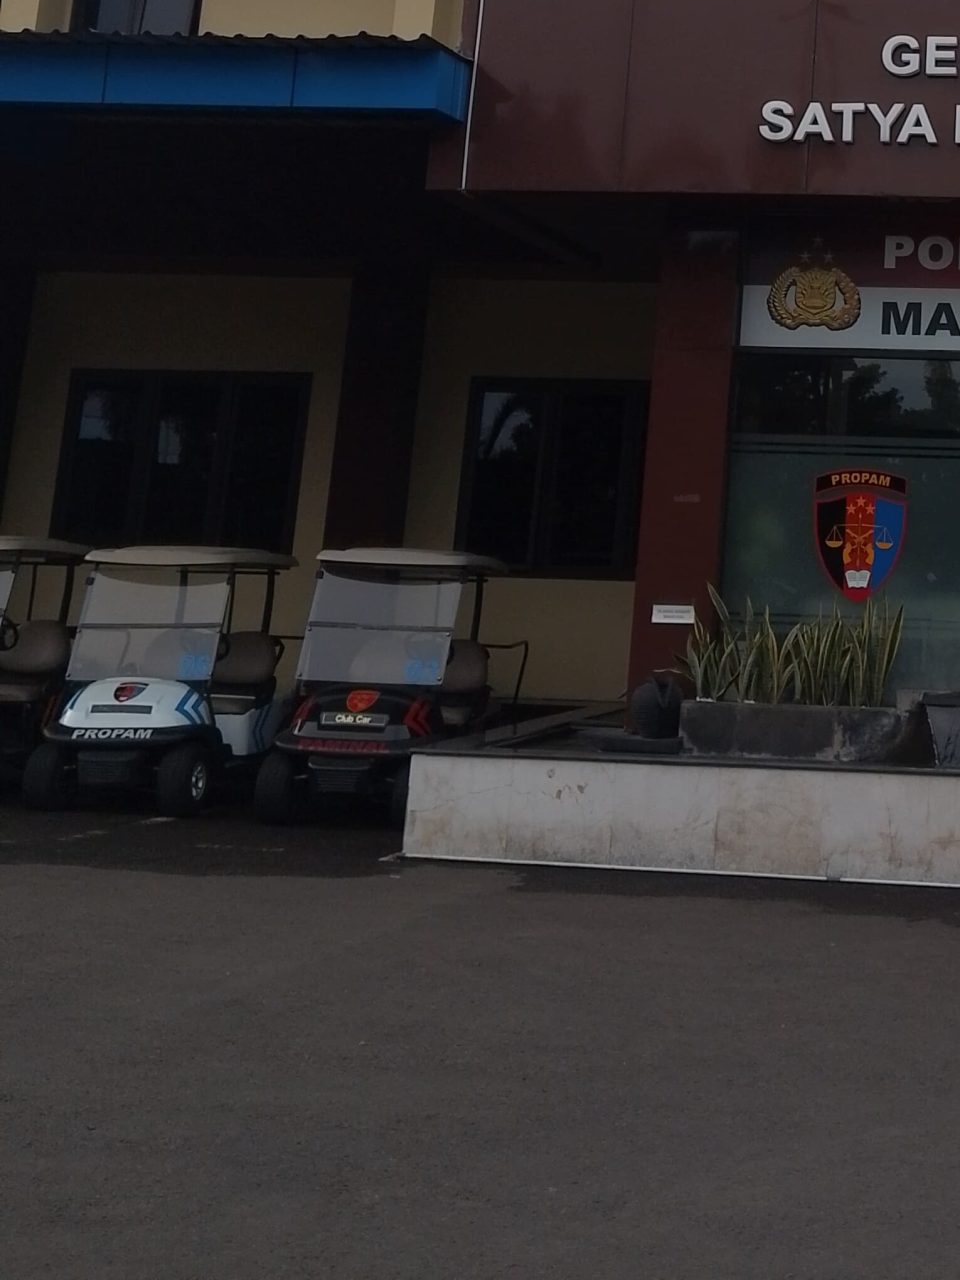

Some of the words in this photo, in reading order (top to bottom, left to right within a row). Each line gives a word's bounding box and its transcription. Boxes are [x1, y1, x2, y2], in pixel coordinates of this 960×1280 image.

[758, 100, 938, 146] SATYA
[831, 472, 891, 489] PROPAM
[335, 714, 354, 723] Club
[356, 715, 372, 724] Car
[71, 728, 154, 740] PROPAM
